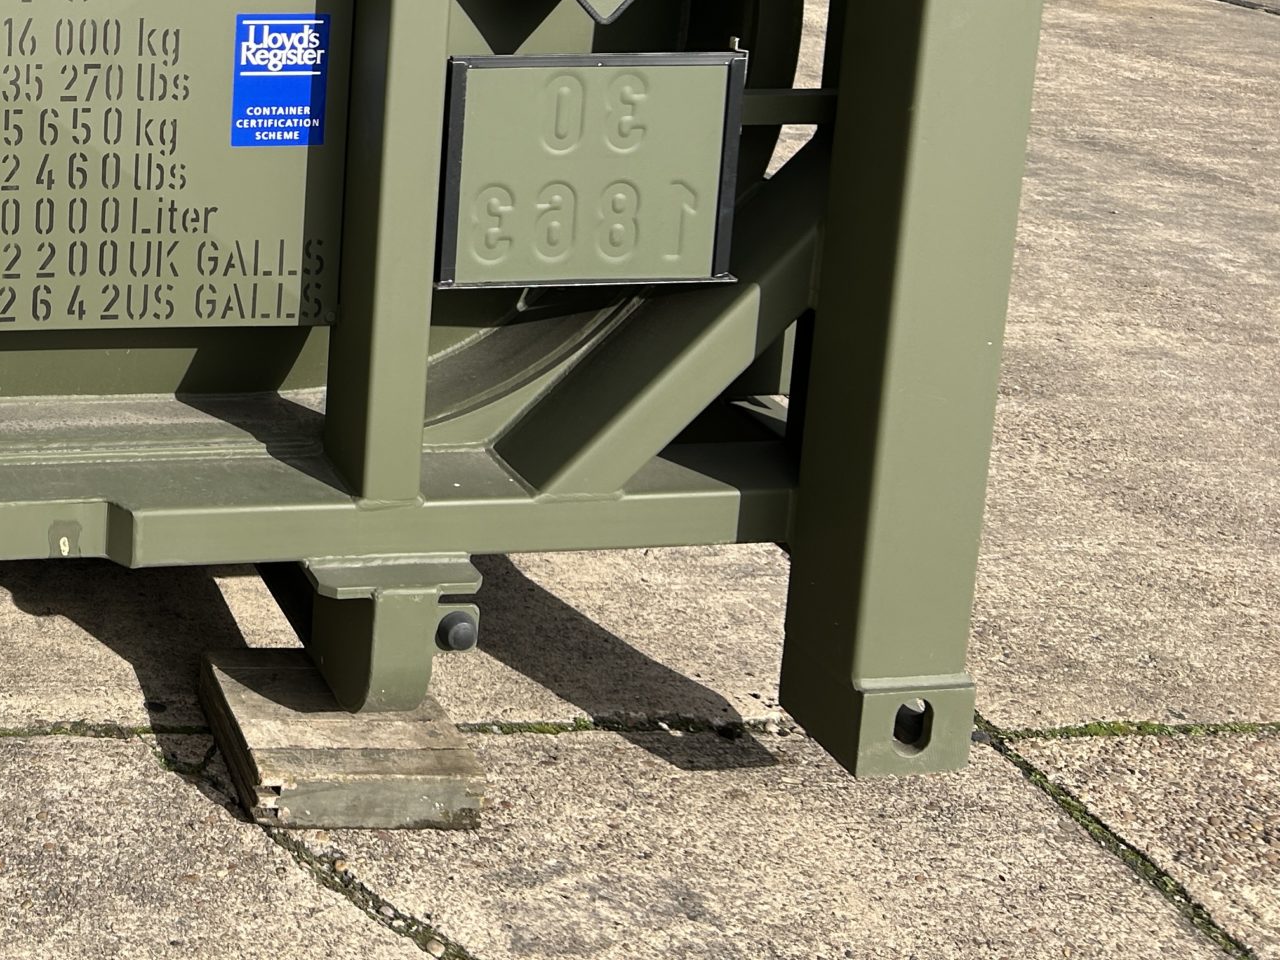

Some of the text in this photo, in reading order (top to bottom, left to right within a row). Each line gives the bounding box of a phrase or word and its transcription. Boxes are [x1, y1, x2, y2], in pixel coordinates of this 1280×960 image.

[137, 17, 181, 67] kg
[248, 25, 320, 50] Lloyd's
[240, 41, 325, 72] Register
[136, 63, 190, 102] lbs
[235, 118, 320, 128] CERTIFICATION
[246, 106, 311, 116] CONTAINER
[255, 131, 300, 140] SCHEME
[196, 239, 324, 277] GALLS
[194, 282, 323, 320] GALLS
